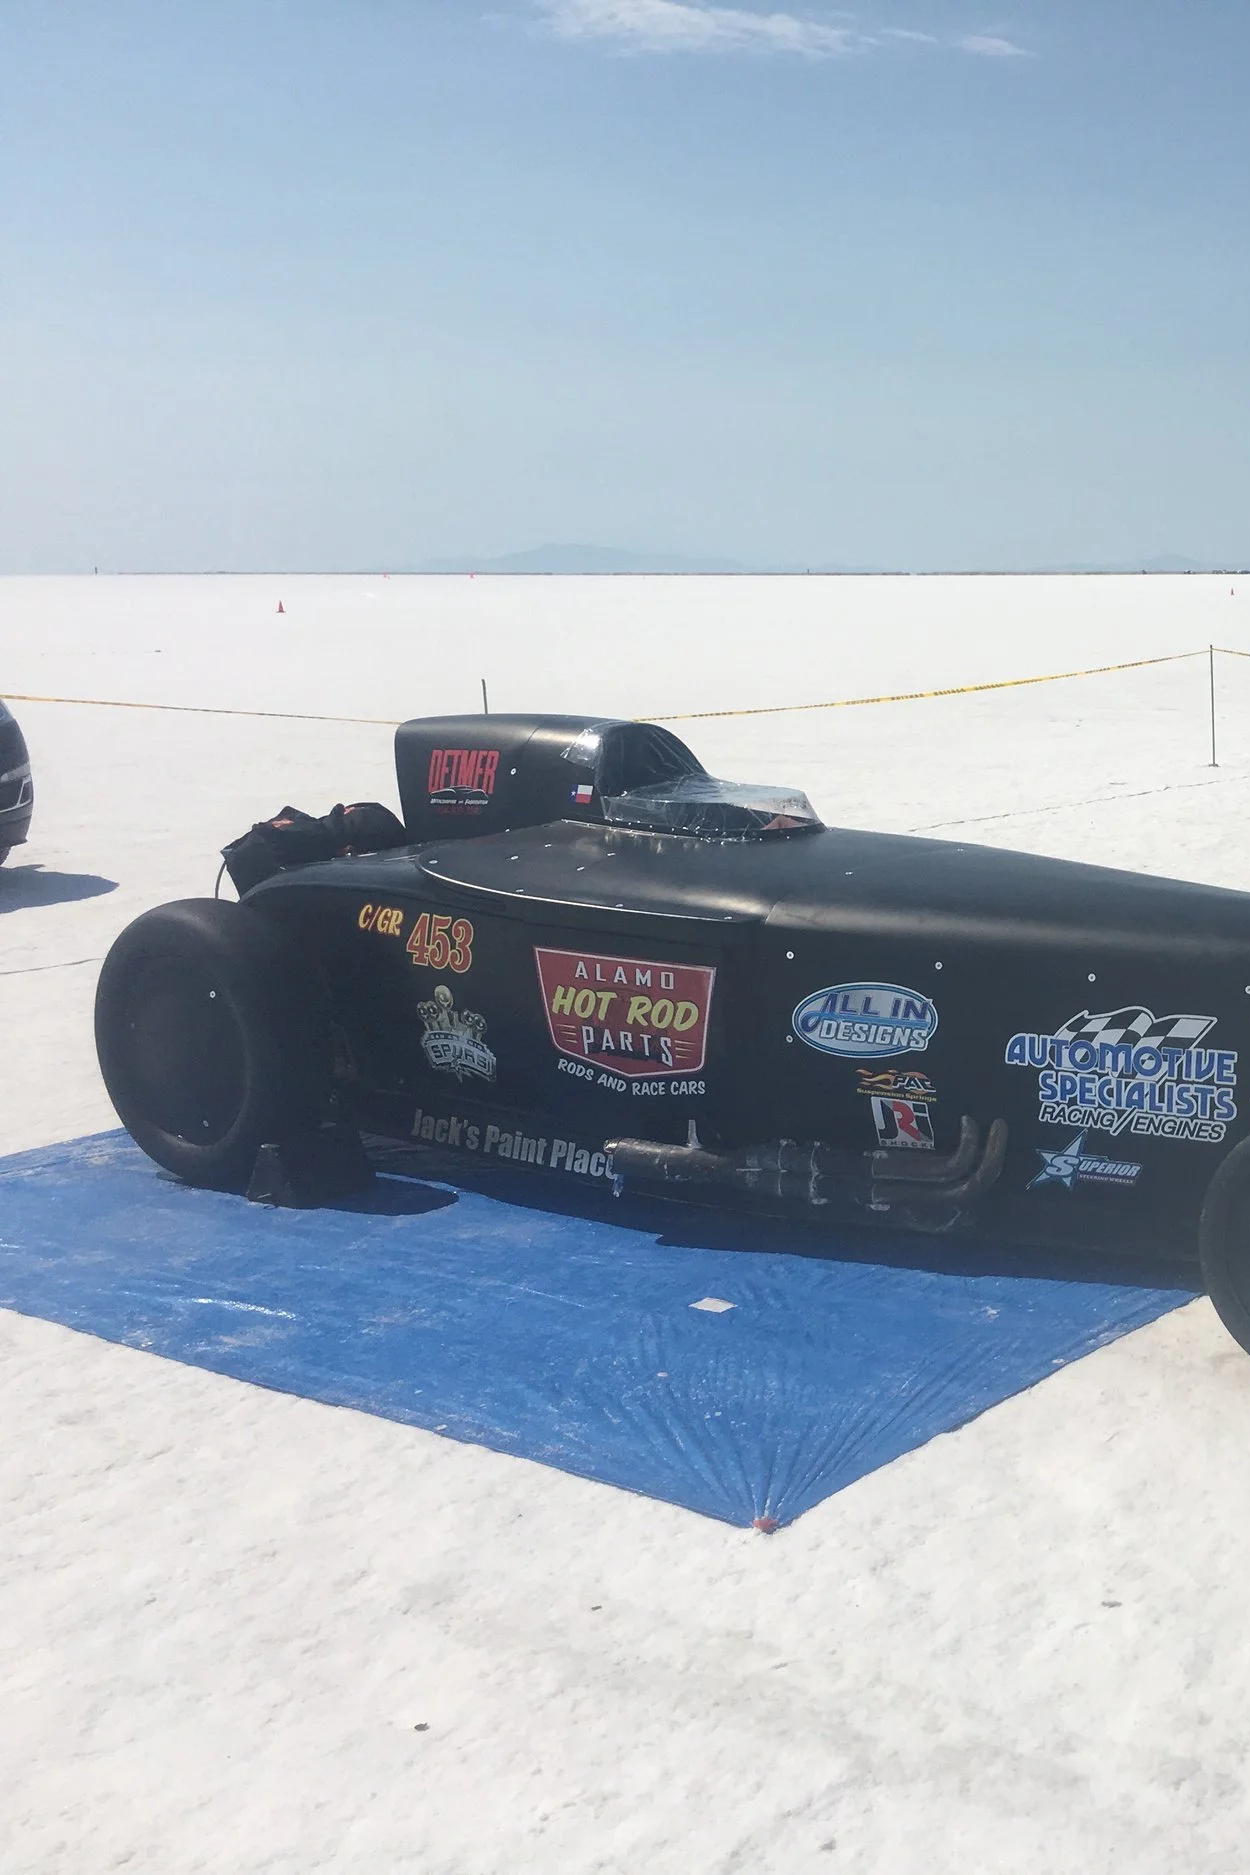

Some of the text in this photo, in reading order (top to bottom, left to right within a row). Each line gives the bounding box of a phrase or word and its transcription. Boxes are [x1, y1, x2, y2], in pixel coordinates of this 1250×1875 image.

[428, 749, 500, 795] DETMER
[358, 904, 404, 936] C/GR
[406, 912, 474, 974] 453
[574, 961, 675, 990] ALAMO
[551, 984, 700, 1032] HOT ROD
[891, 997, 930, 1020] IN
[581, 1025, 674, 1067] PARTS
[819, 1019, 929, 1049] DESIGNS
[557, 1058, 706, 1096] RODS AND RACE CARS
[1005, 1033, 1238, 1085] AUTOMOTIVE
[891, 1075, 937, 1093] PAC
[1038, 1070, 1238, 1122] SPECIALISTS
[410, 1108, 480, 1150] Jack's
[484, 1124, 547, 1166] Paint
[1045, 1155, 1141, 1177] SUPERIOR
